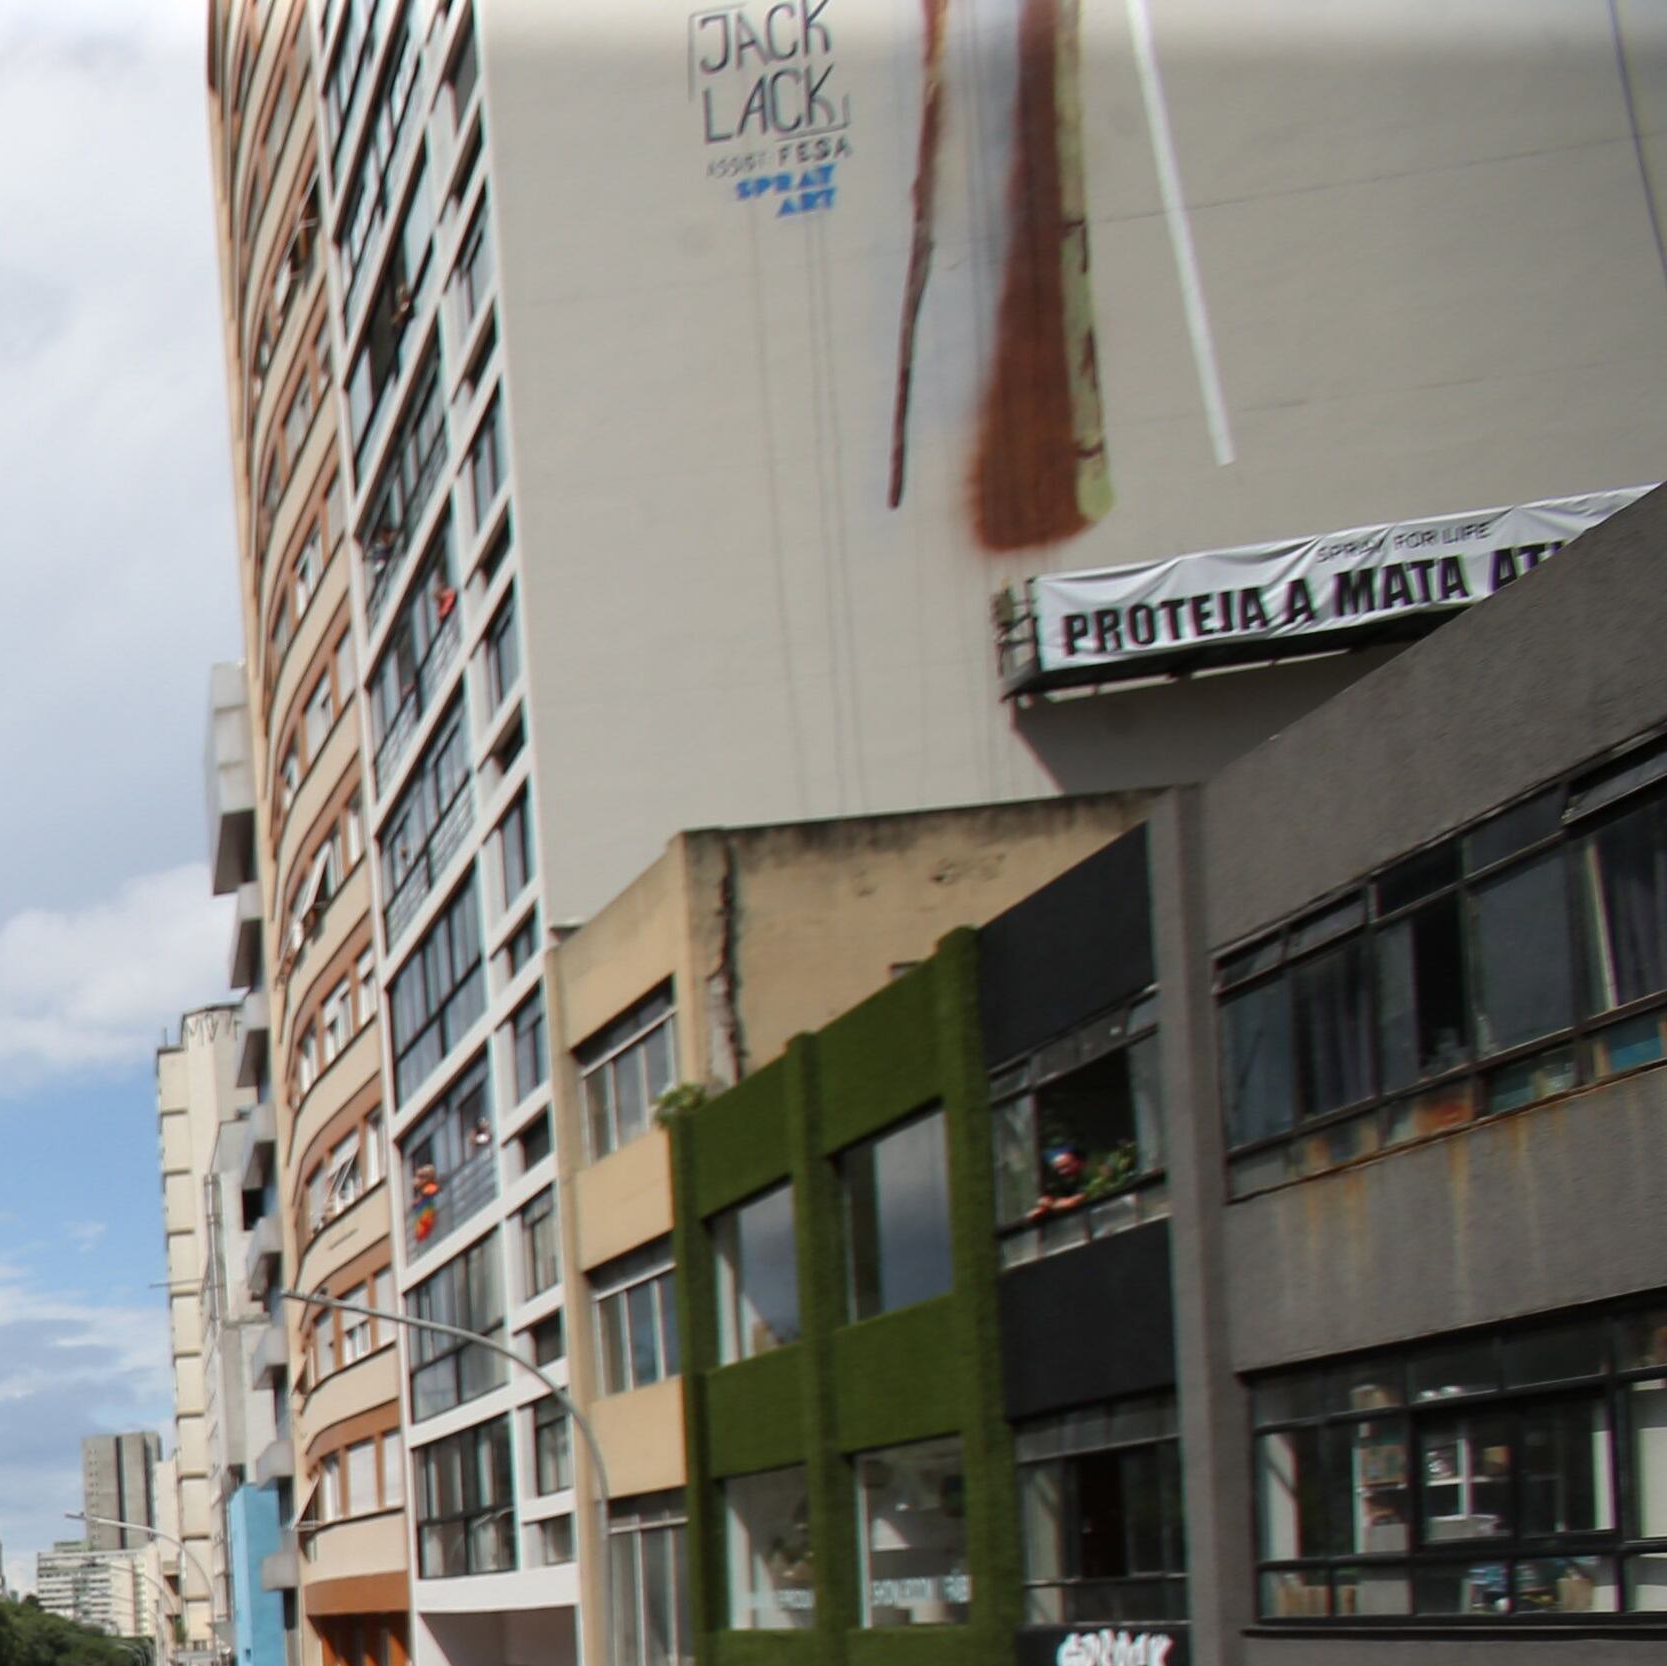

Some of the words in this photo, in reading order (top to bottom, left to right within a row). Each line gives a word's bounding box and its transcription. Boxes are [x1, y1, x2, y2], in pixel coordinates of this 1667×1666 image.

[698, 0, 831, 74] JACK
[701, 63, 835, 144] LACK
[1393, 529, 1438, 552] FOR
[1441, 520, 1493, 545] LIFE
[1062, 586, 1269, 657] PROTEJA
[1284, 577, 1315, 626] A
[1332, 554, 1470, 619] MATA
